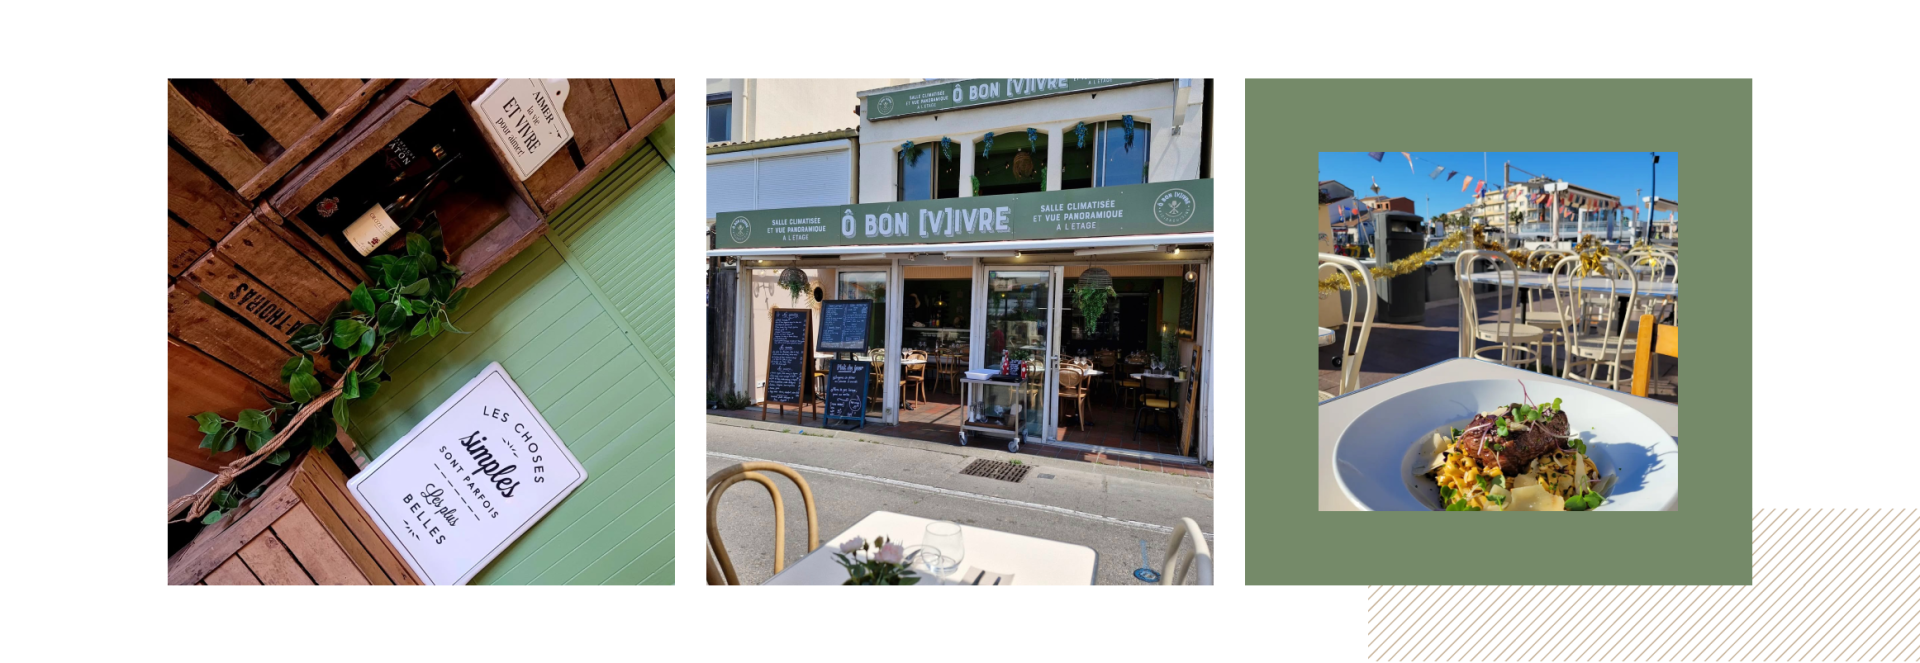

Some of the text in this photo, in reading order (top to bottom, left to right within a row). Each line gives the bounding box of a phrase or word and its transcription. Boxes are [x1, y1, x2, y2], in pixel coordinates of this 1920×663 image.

[533, 91, 554, 124] AIMER
[953, 84, 963, 103] Ô
[969, 82, 1000, 100] BON
[502, 96, 541, 154] ET VIVRE
[527, 106, 540, 126] la vie
[388, 142, 411, 165] ATON
[495, 117, 525, 157] pour aimer!
[842, 206, 1011, 238] Ô BON [V]IVRE
[1040, 203, 1064, 212] SALLE
[1045, 213, 1061, 221] VUE
[1064, 210, 1123, 221] PANORAMIQUE
[483, 405, 544, 483] LES CHOSES
[439, 445, 499, 519] SONT PARFOIS
[458, 430, 520, 498] simples
[403, 493, 446, 545] BELLES
[420, 483, 459, 527] Les plus
